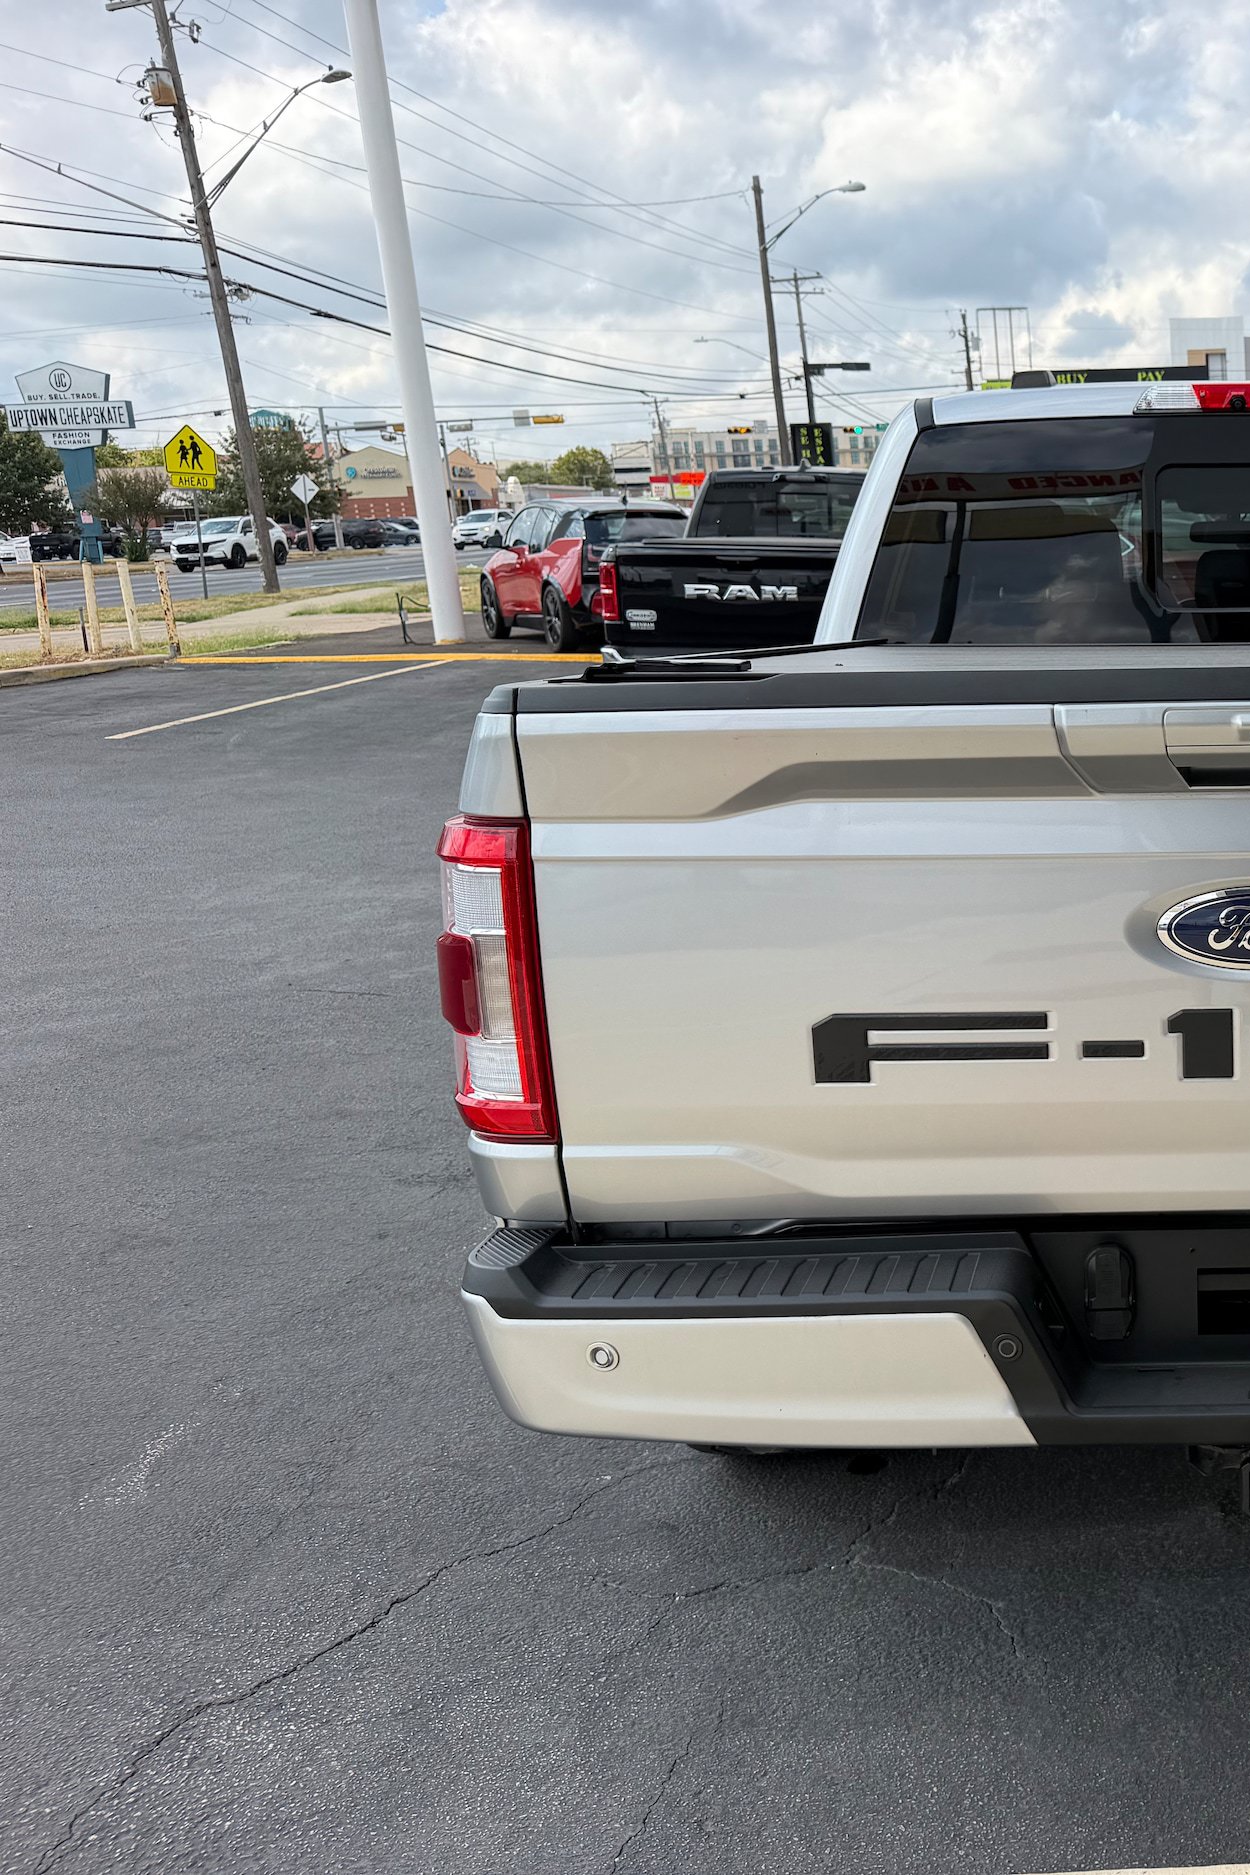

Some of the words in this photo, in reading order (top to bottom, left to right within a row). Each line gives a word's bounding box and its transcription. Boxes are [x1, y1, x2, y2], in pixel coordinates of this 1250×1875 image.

[54, 373, 67, 388] UC
[1056, 373, 1088, 384] BUY
[1137, 370, 1166, 382] PAY
[48, 392, 71, 400] SELL.
[9, 408, 58, 428] UPTOWN
[59, 406, 126, 426] CHEAPSKATE
[52, 431, 90, 440] FASHION
[53, 438, 91, 446] EXCHANGE
[178, 476, 208, 487] AHEAD
[683, 583, 799, 602] RAM
